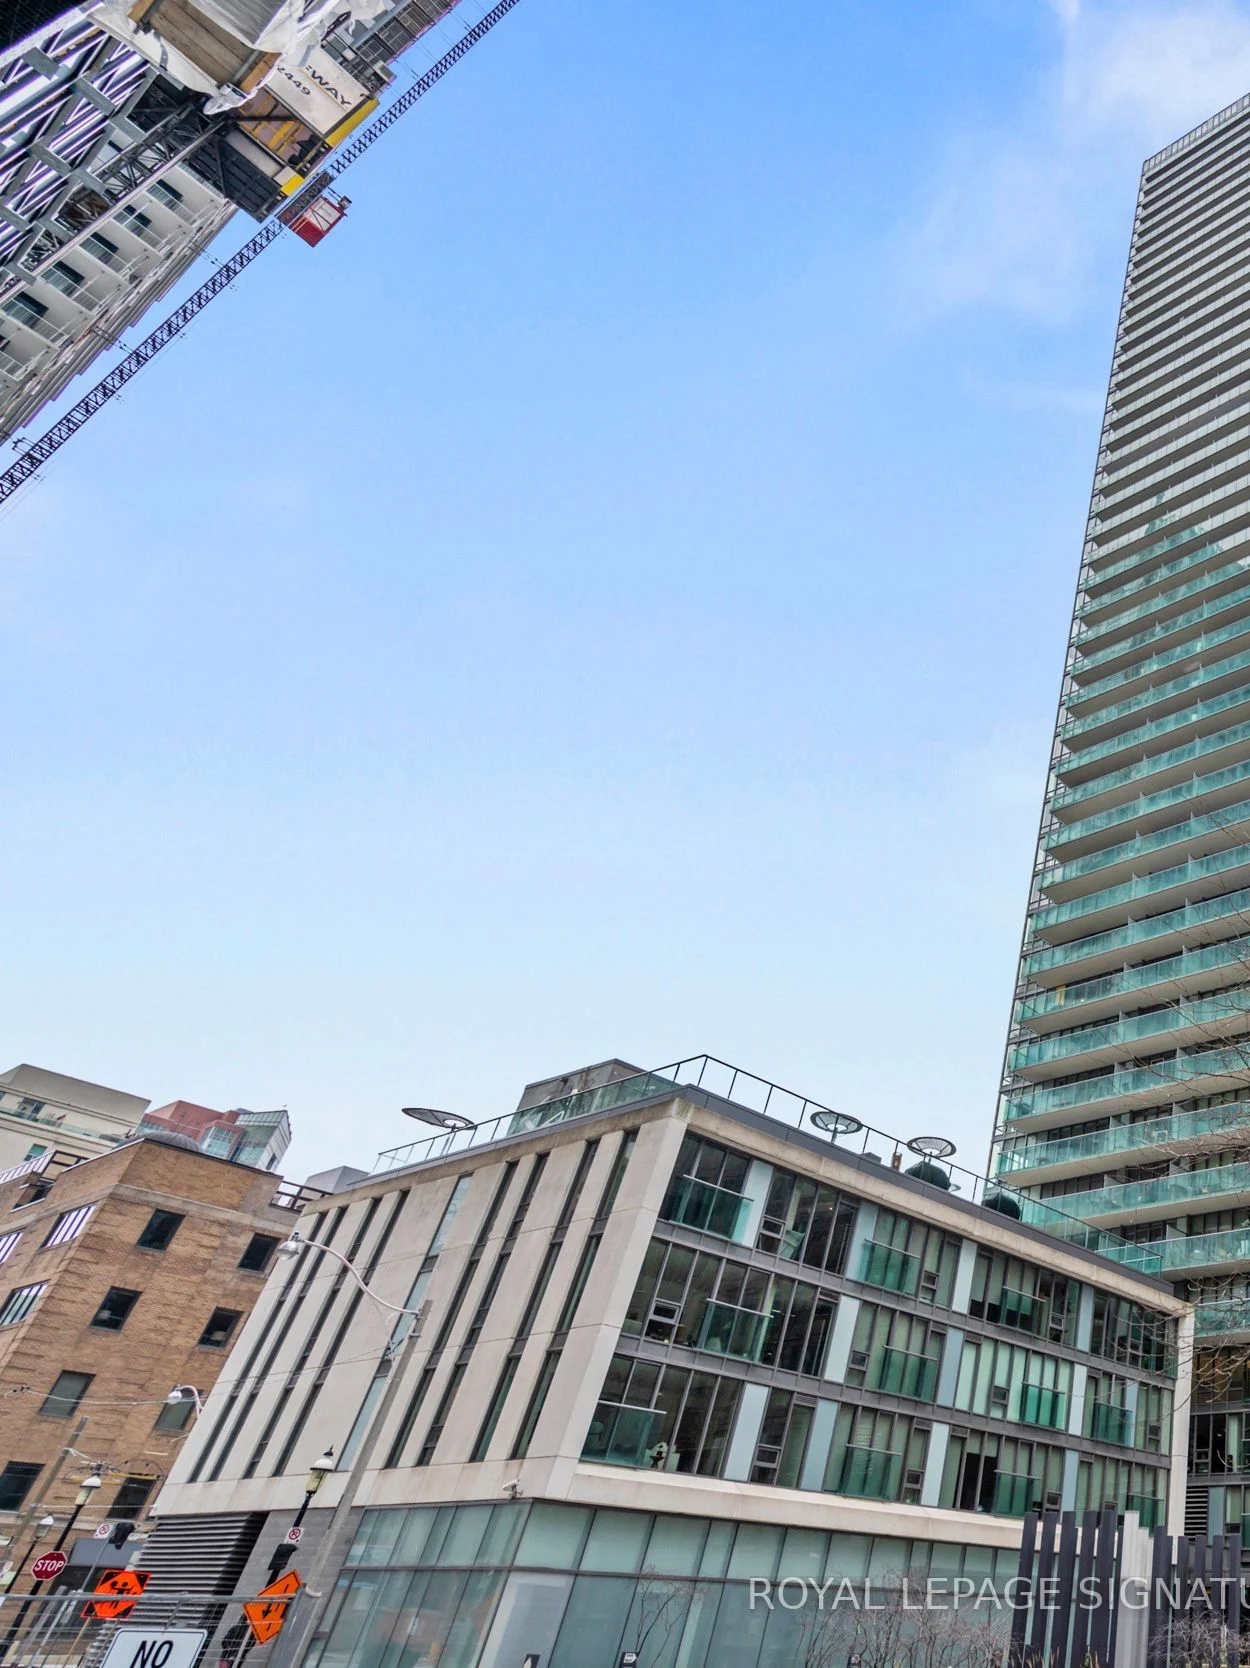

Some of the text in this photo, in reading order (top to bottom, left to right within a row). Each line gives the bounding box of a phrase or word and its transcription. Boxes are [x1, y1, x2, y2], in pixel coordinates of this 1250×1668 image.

[305, 65, 352, 105] WAY
[34, 1560, 65, 1572] STOP
[130, 1640, 174, 1668] NO
